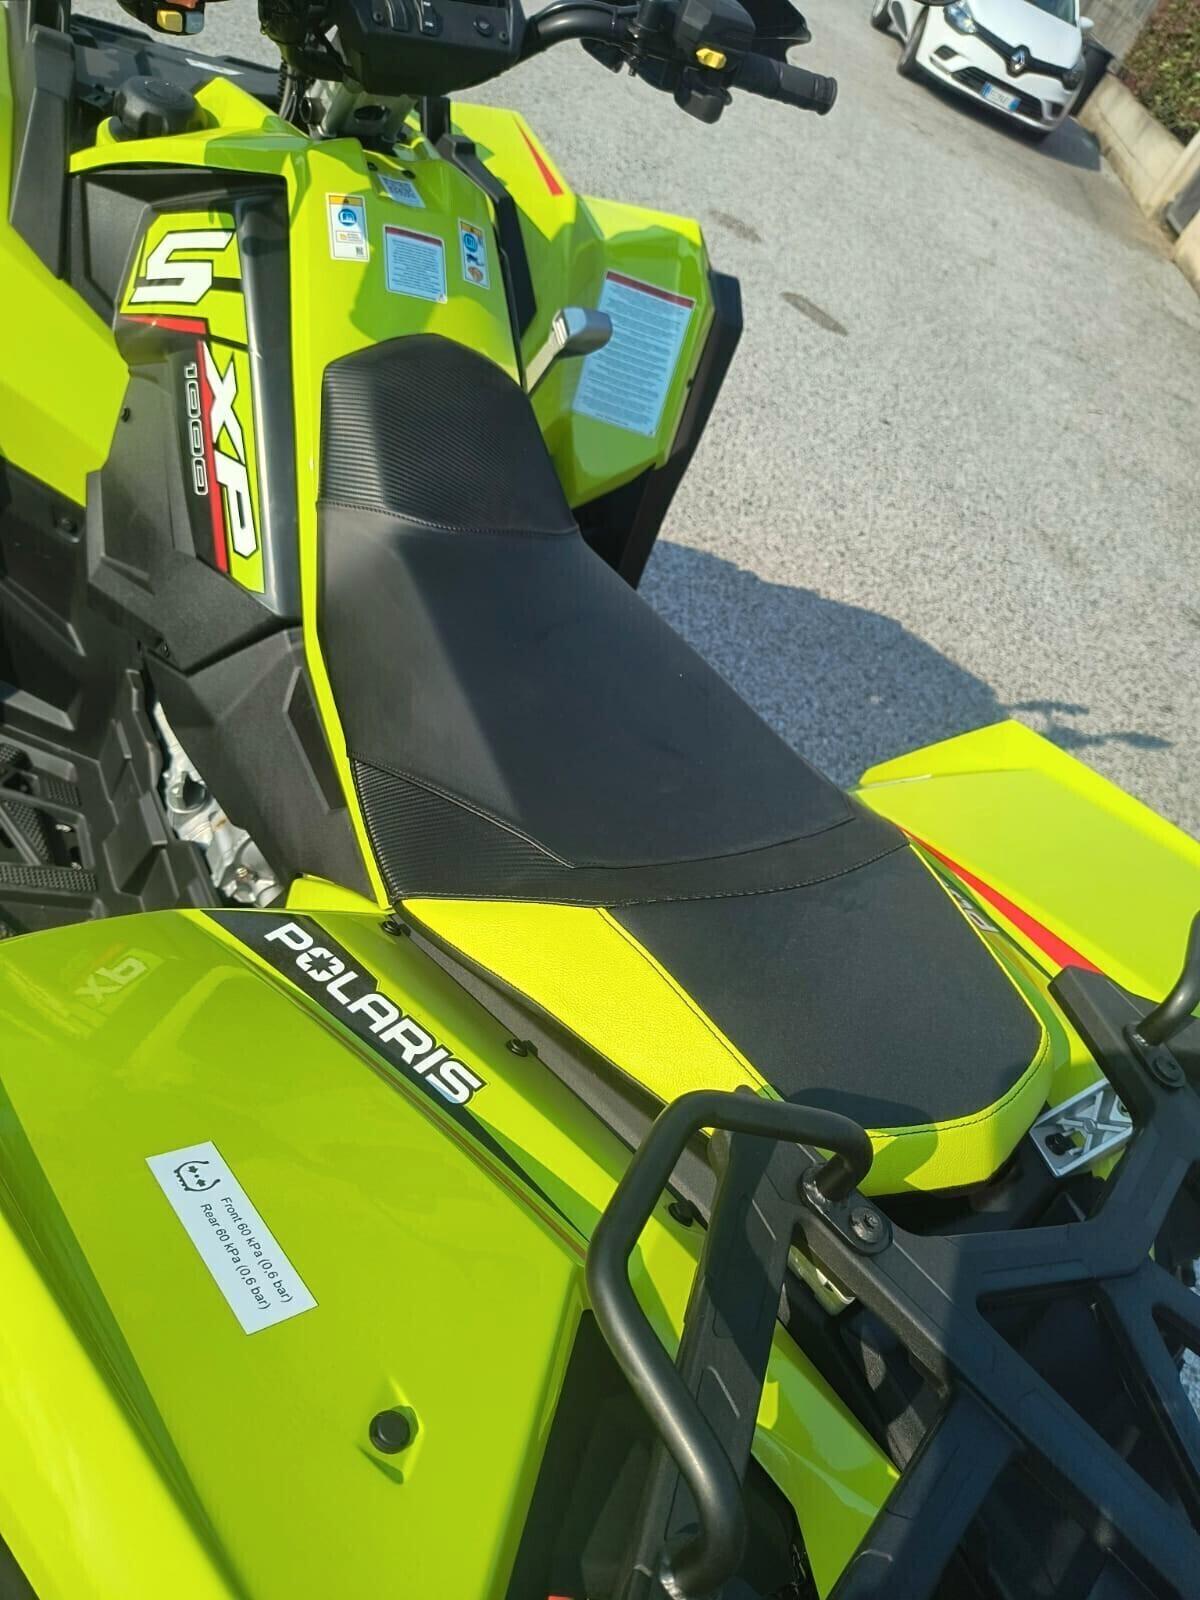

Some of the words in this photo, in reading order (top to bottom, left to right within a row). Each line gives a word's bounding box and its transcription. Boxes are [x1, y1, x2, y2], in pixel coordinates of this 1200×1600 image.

[184, 362, 209, 496] 1000
[203, 340, 259, 559] XP
[264, 922, 483, 1105] POLARIS
[200, 1203, 220, 1227] Rear
[215, 1228, 230, 1242] 60
[224, 1242, 241, 1264] kPa
[235, 1264, 256, 1286] (0,6
[250, 1286, 271, 1310] bar)
[221, 1197, 242, 1223] Front
[237, 1223, 252, 1237] 60
[246, 1236, 263, 1258] kPa
[257, 1258, 279, 1279] (0,6
[272, 1279, 293, 1303] bar)
